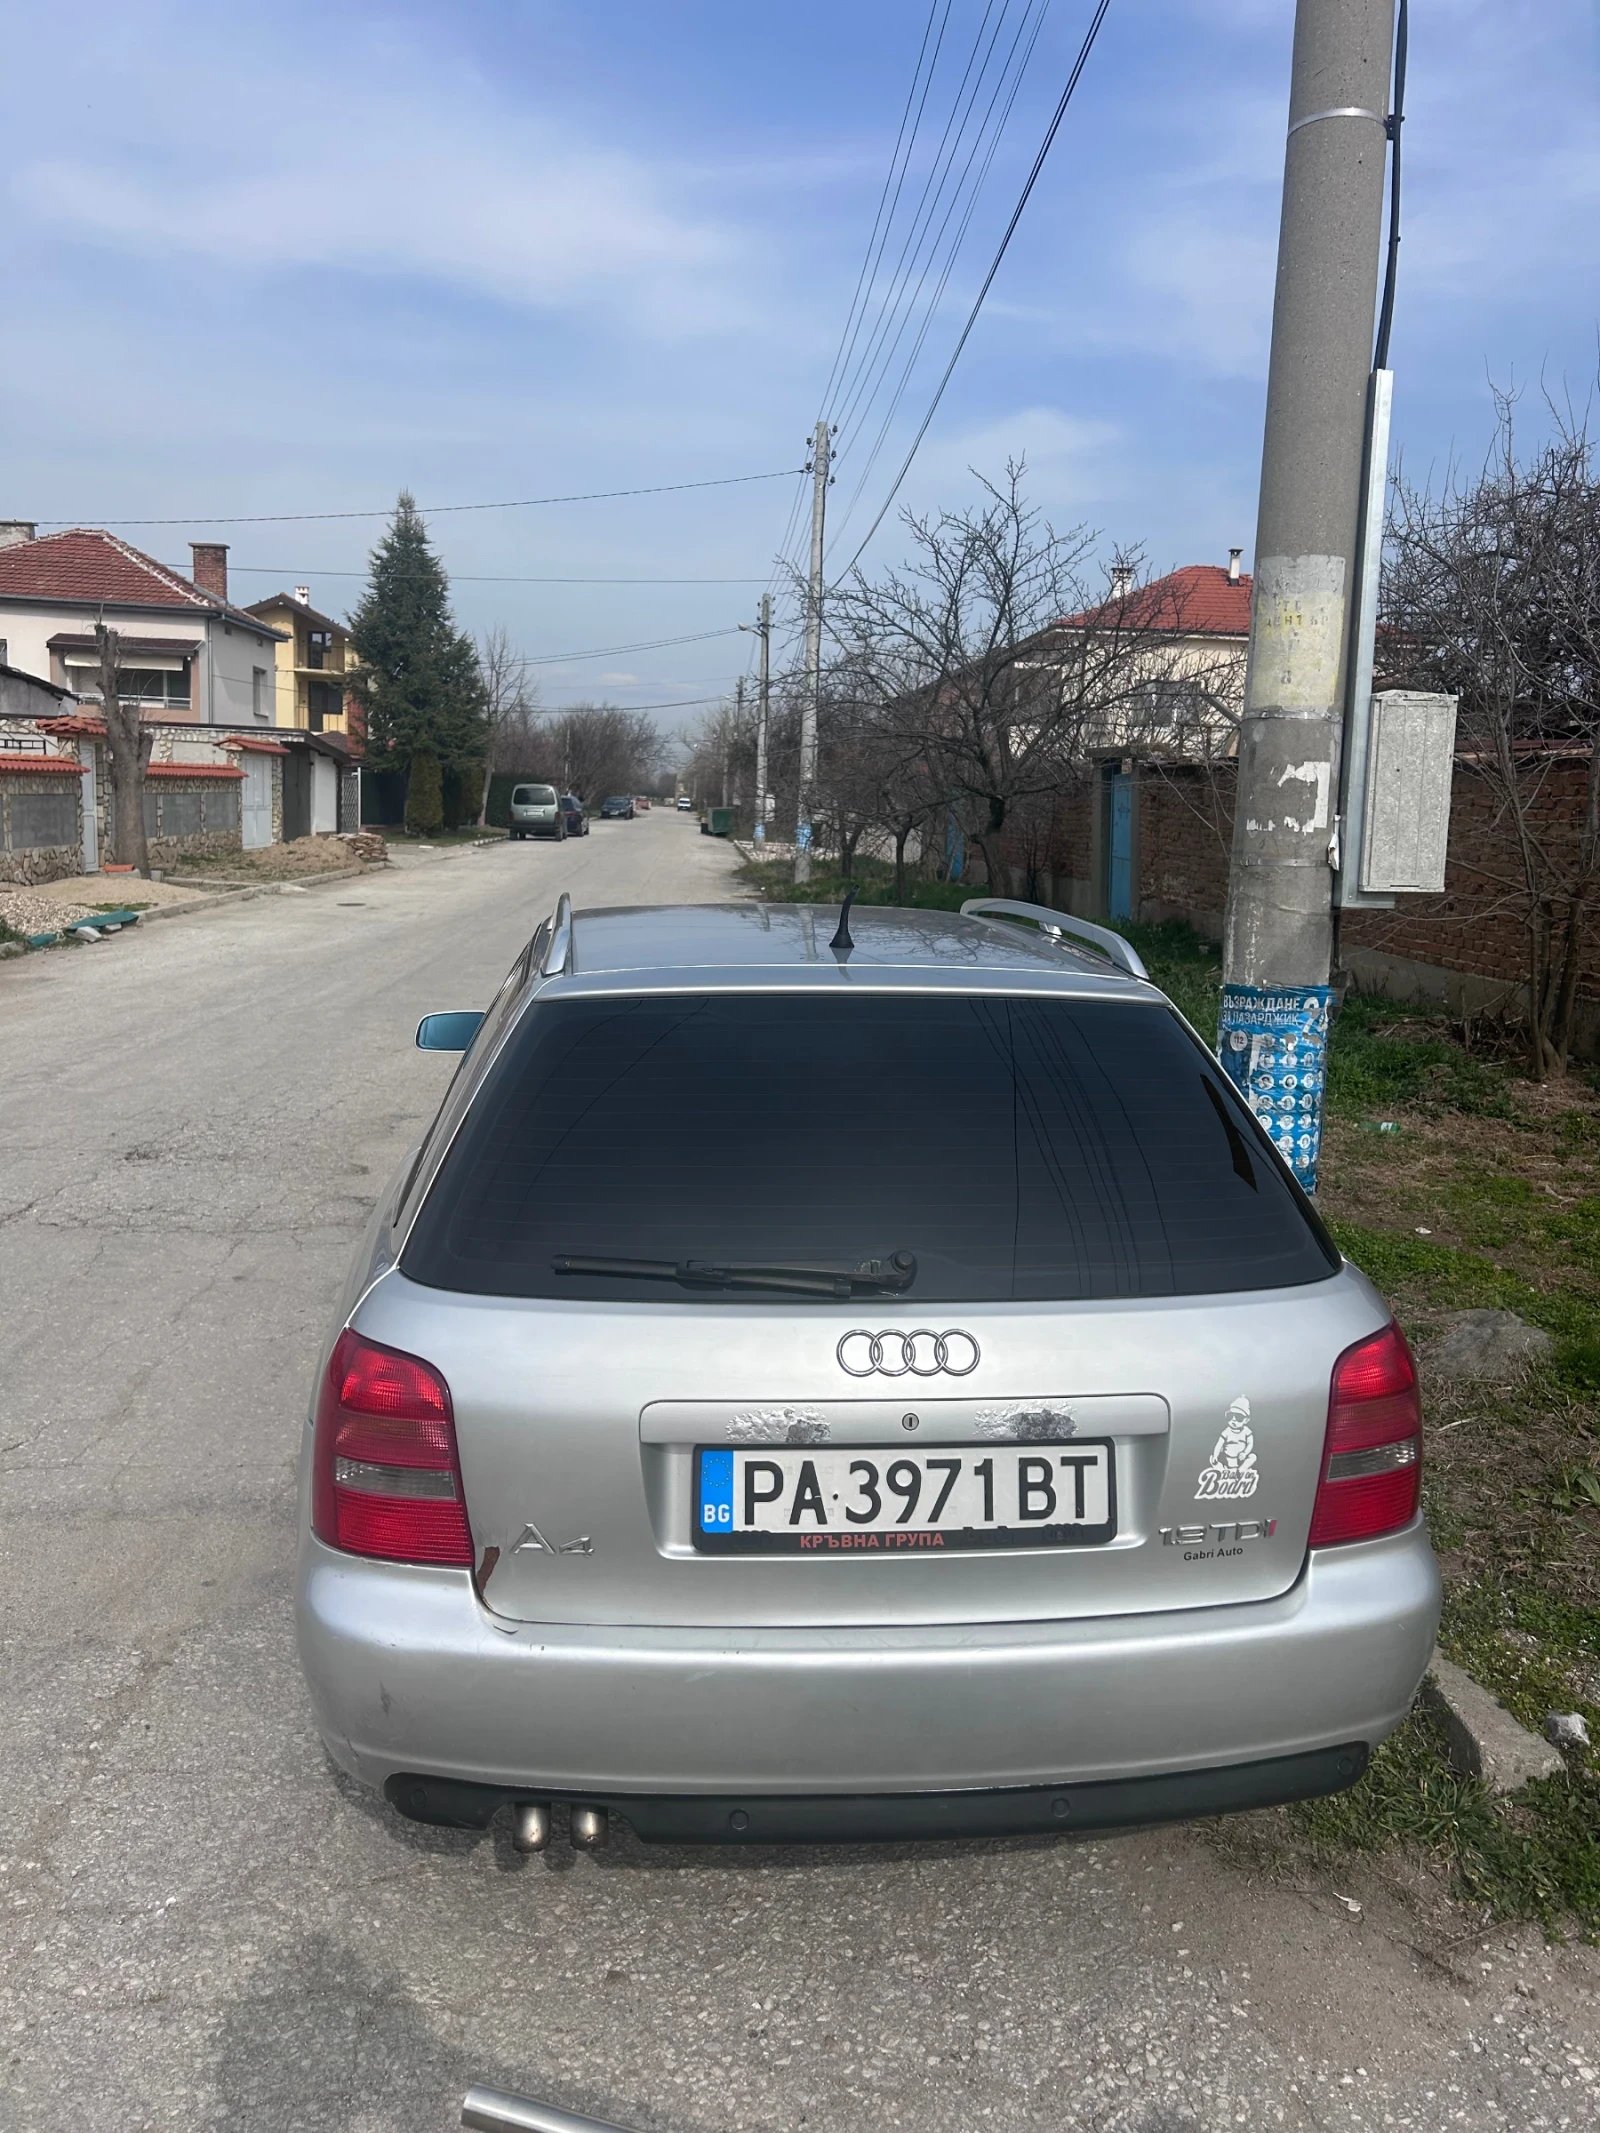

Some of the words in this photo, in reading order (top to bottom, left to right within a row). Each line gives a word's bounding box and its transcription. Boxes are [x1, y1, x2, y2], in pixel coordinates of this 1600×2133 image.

[1223, 995, 1300, 1012] ВЪЗРАЖДАНЕ
[845, 1458, 994, 1525] 3971
[1198, 1469, 1257, 1497] Board
[703, 1504, 731, 1524] BG
[1209, 1518, 1277, 1542] TDI
[800, 1533, 880, 1549] КРЪВНА
[885, 1532, 945, 1547] ГРУПА
[1183, 1549, 1214, 1561] Gabri
[1217, 1546, 1243, 1557] Auto
